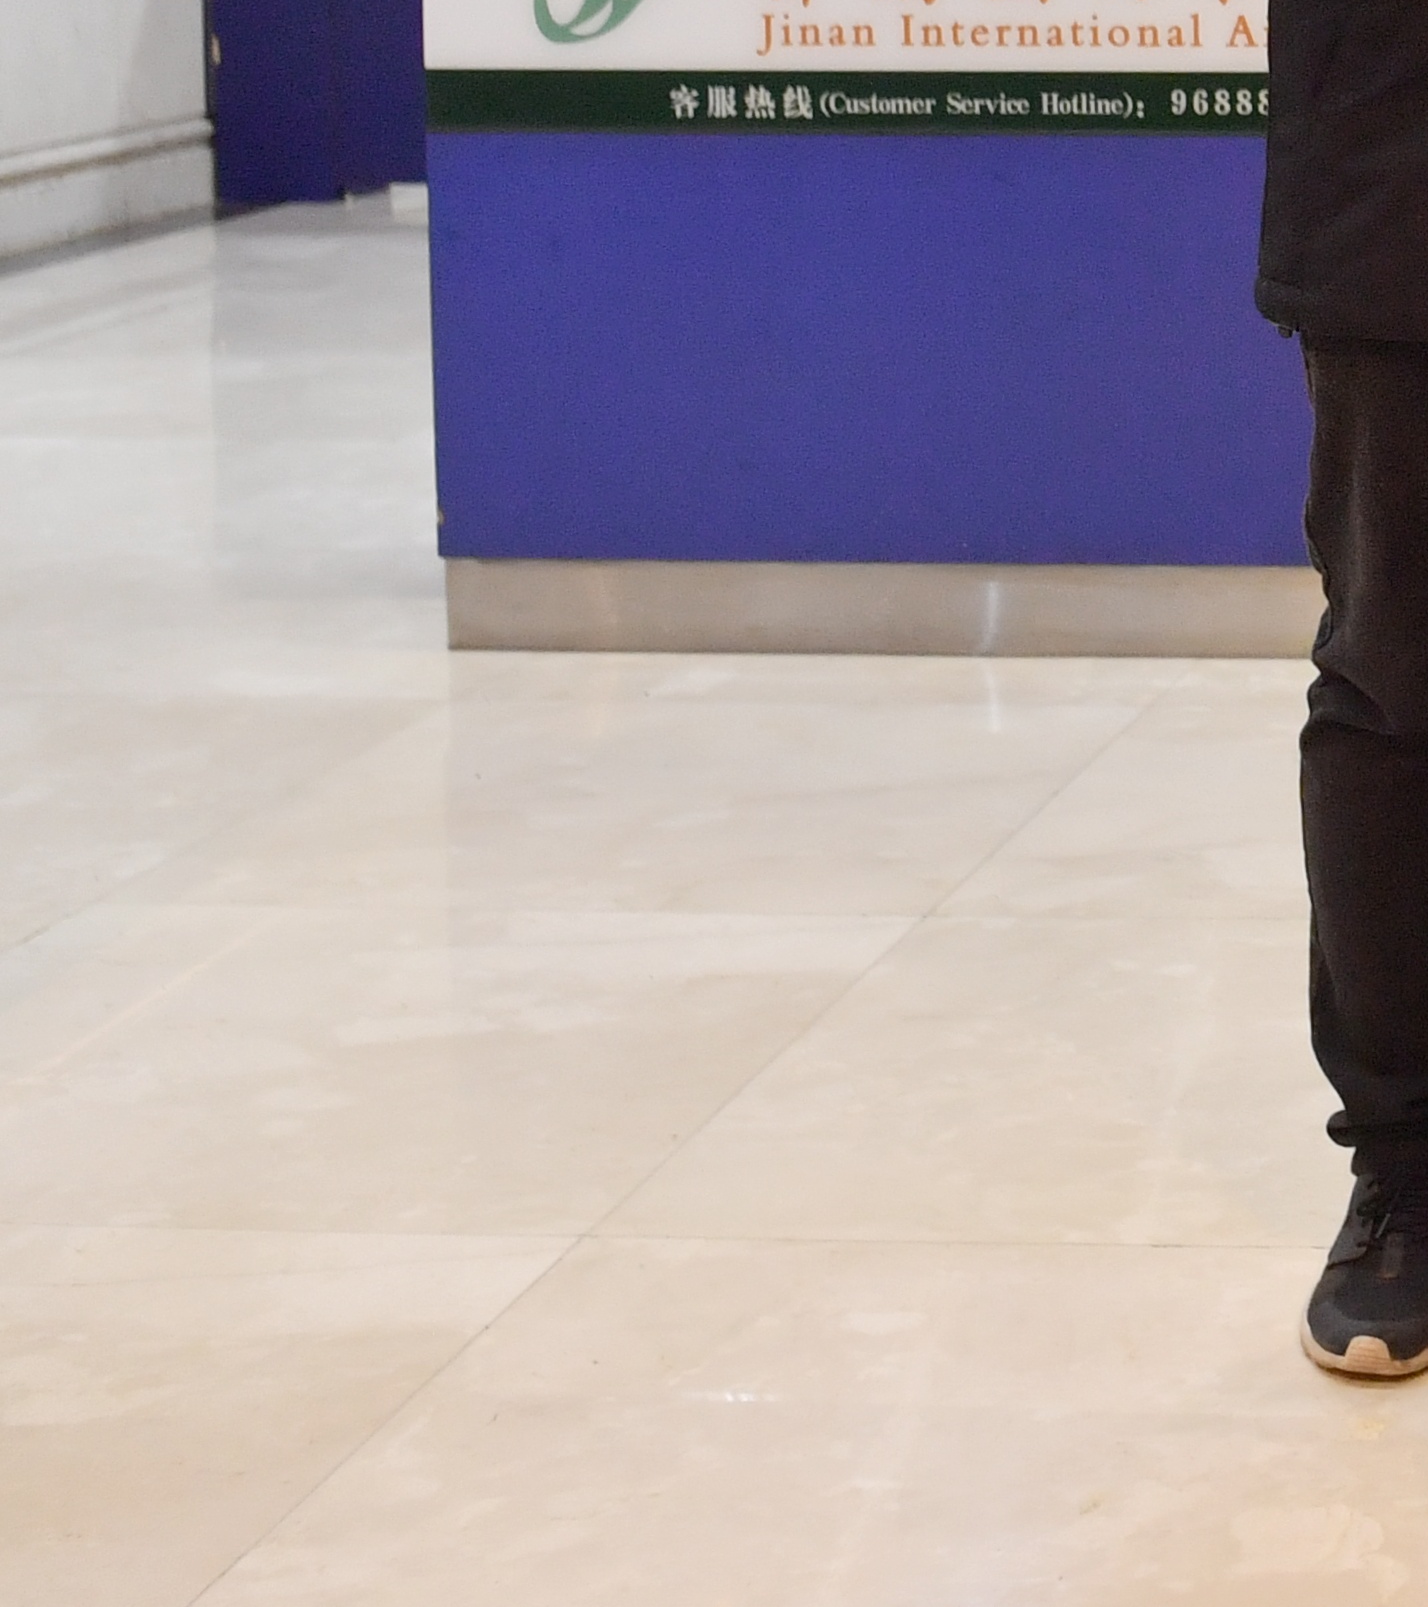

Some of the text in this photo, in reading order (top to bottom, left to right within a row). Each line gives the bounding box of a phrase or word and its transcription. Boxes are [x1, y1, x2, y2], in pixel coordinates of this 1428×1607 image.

[756, 13, 877, 57] Jinan
[901, 12, 1204, 48] International
[1226, 14, 1269, 48] A
[668, 83, 813, 120] 客服热线
[946, 91, 1030, 116] Service
